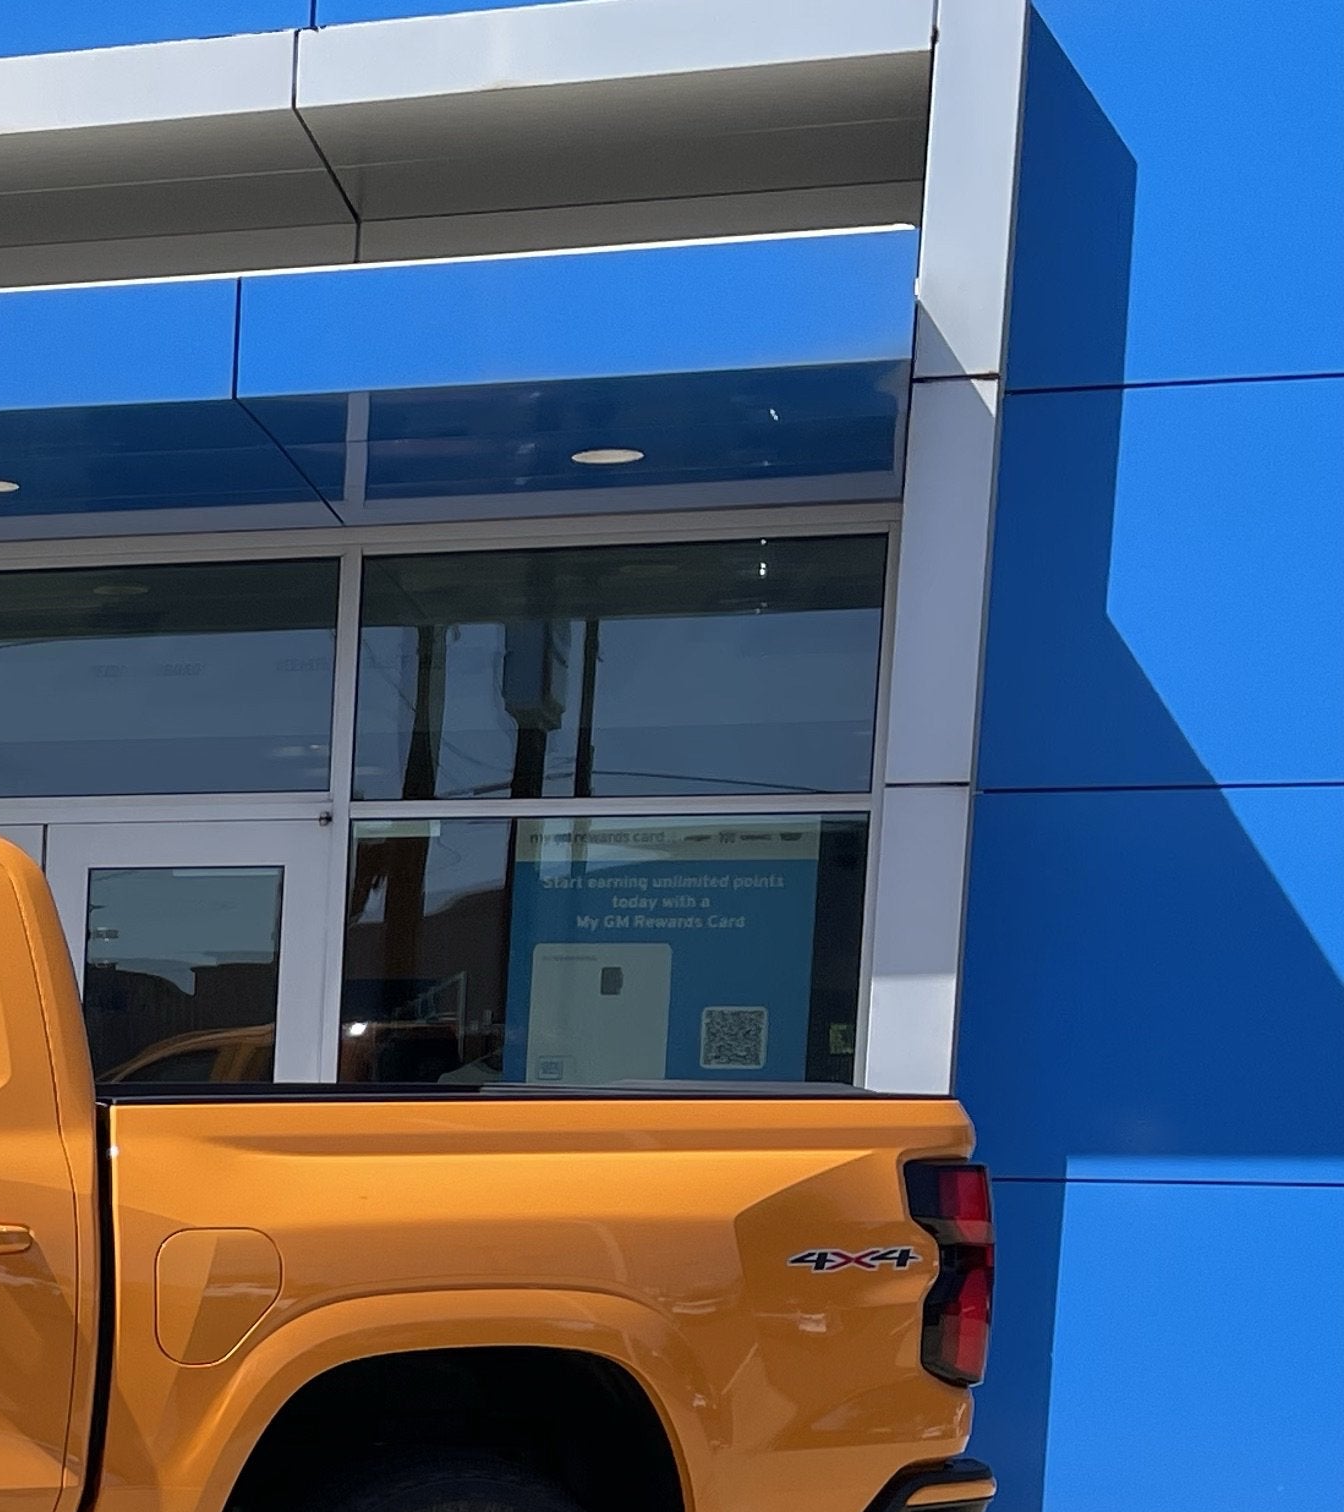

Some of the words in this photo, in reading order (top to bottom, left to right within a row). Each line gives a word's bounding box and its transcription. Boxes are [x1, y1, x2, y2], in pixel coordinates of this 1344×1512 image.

[574, 832, 630, 844] rewards
[632, 831, 665, 843] card
[543, 875, 584, 889] Start
[587, 876, 647, 891] earning
[651, 874, 730, 888] unlimited
[733, 873, 785, 890] points
[612, 894, 658, 911] today
[662, 894, 697, 908] with
[700, 897, 711, 908] a
[576, 914, 599, 931] My
[604, 914, 630, 928] GM
[634, 914, 703, 929] Rewards
[707, 914, 746, 929] Card
